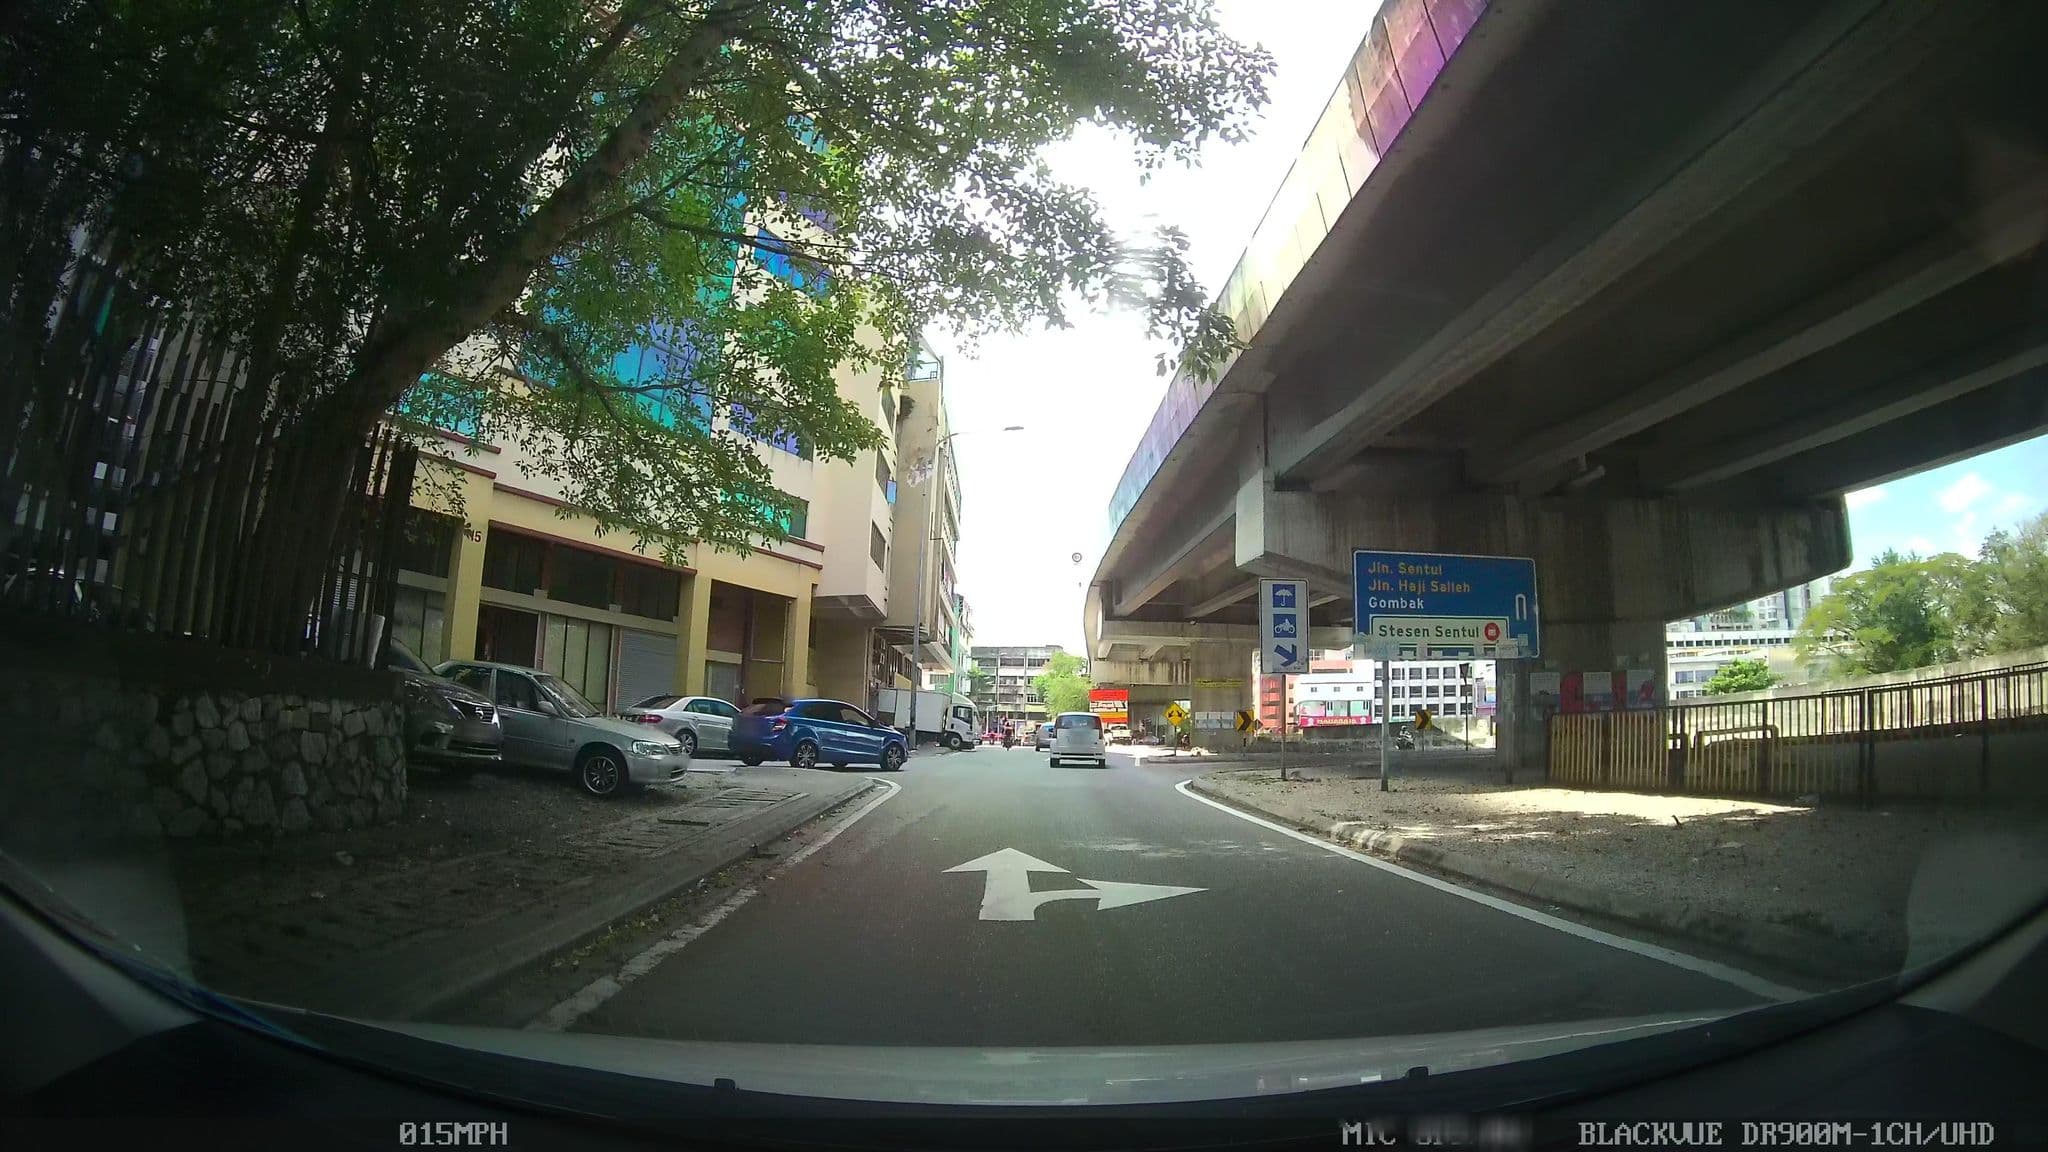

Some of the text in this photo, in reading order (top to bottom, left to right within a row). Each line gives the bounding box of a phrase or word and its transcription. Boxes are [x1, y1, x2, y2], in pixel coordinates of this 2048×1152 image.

[1368, 561, 1443, 575] Jln. Sentul
[1368, 579, 1471, 595] Jln. Haji Salleh
[1369, 596, 1425, 609] Gombak
[1379, 625, 1479, 638] Stesen Sentul
